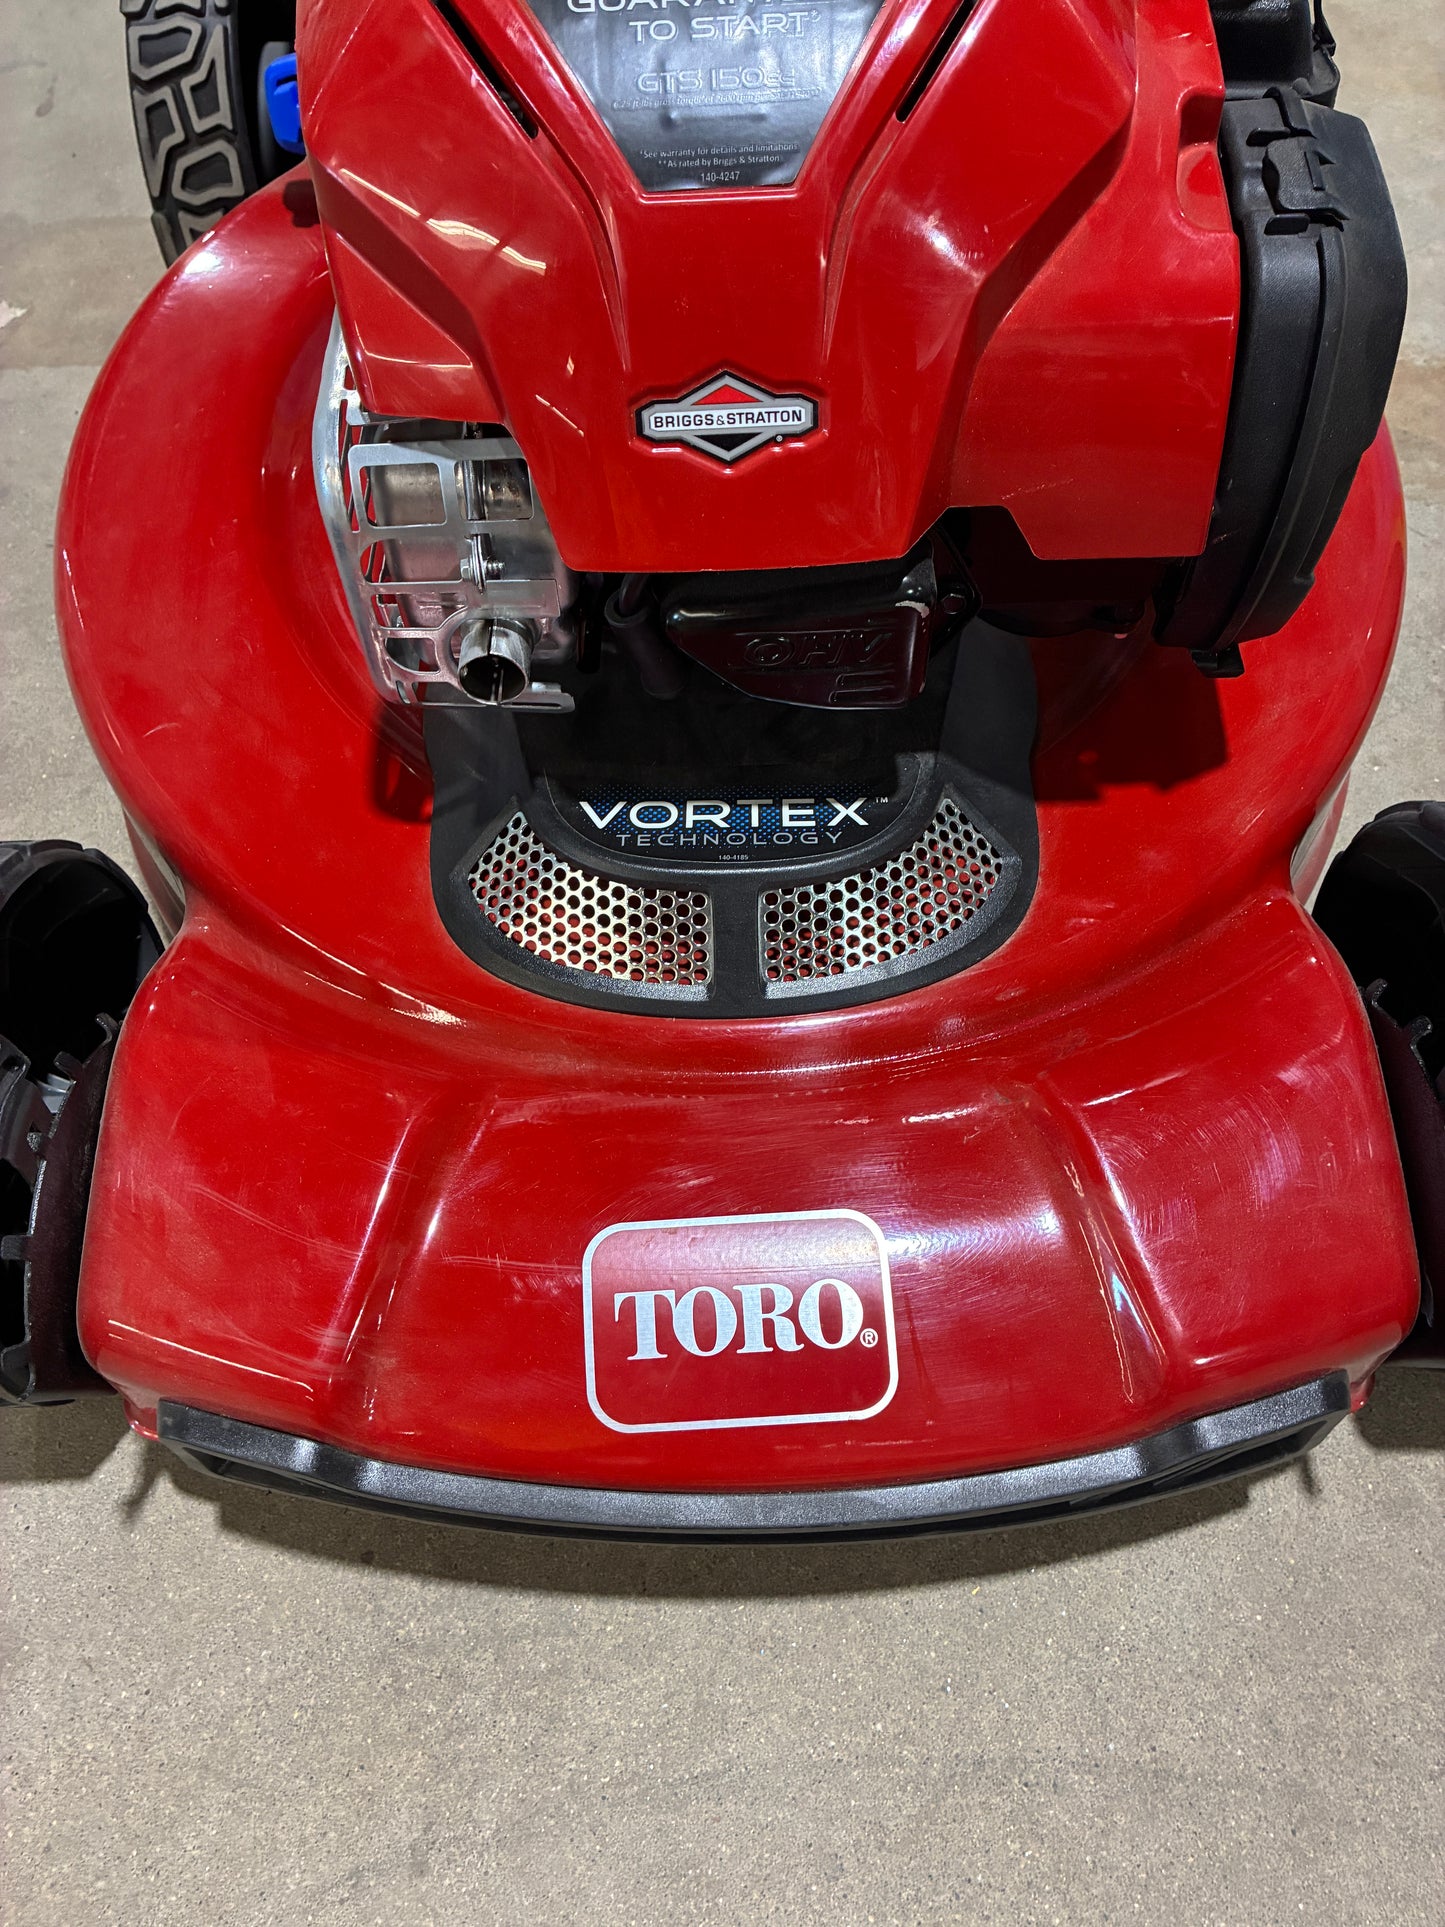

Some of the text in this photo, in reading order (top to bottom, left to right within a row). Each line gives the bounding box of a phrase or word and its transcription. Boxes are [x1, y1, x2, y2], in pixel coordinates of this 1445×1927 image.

[628, 20, 677, 42] TO
[637, 70, 702, 94] GTS
[660, 149, 696, 158] warranty
[697, 147, 709, 155] for
[710, 145, 737, 155] details
[738, 145, 754, 153] and
[678, 158, 700, 168] rated
[701, 158, 711, 167] by
[713, 156, 737, 167] Briggs
[739, 155, 746, 164] &
[747, 154, 780, 164] Stratton
[700, 171, 741, 182] 140-4247
[615, 831, 844, 847] TECHNOLOGY
